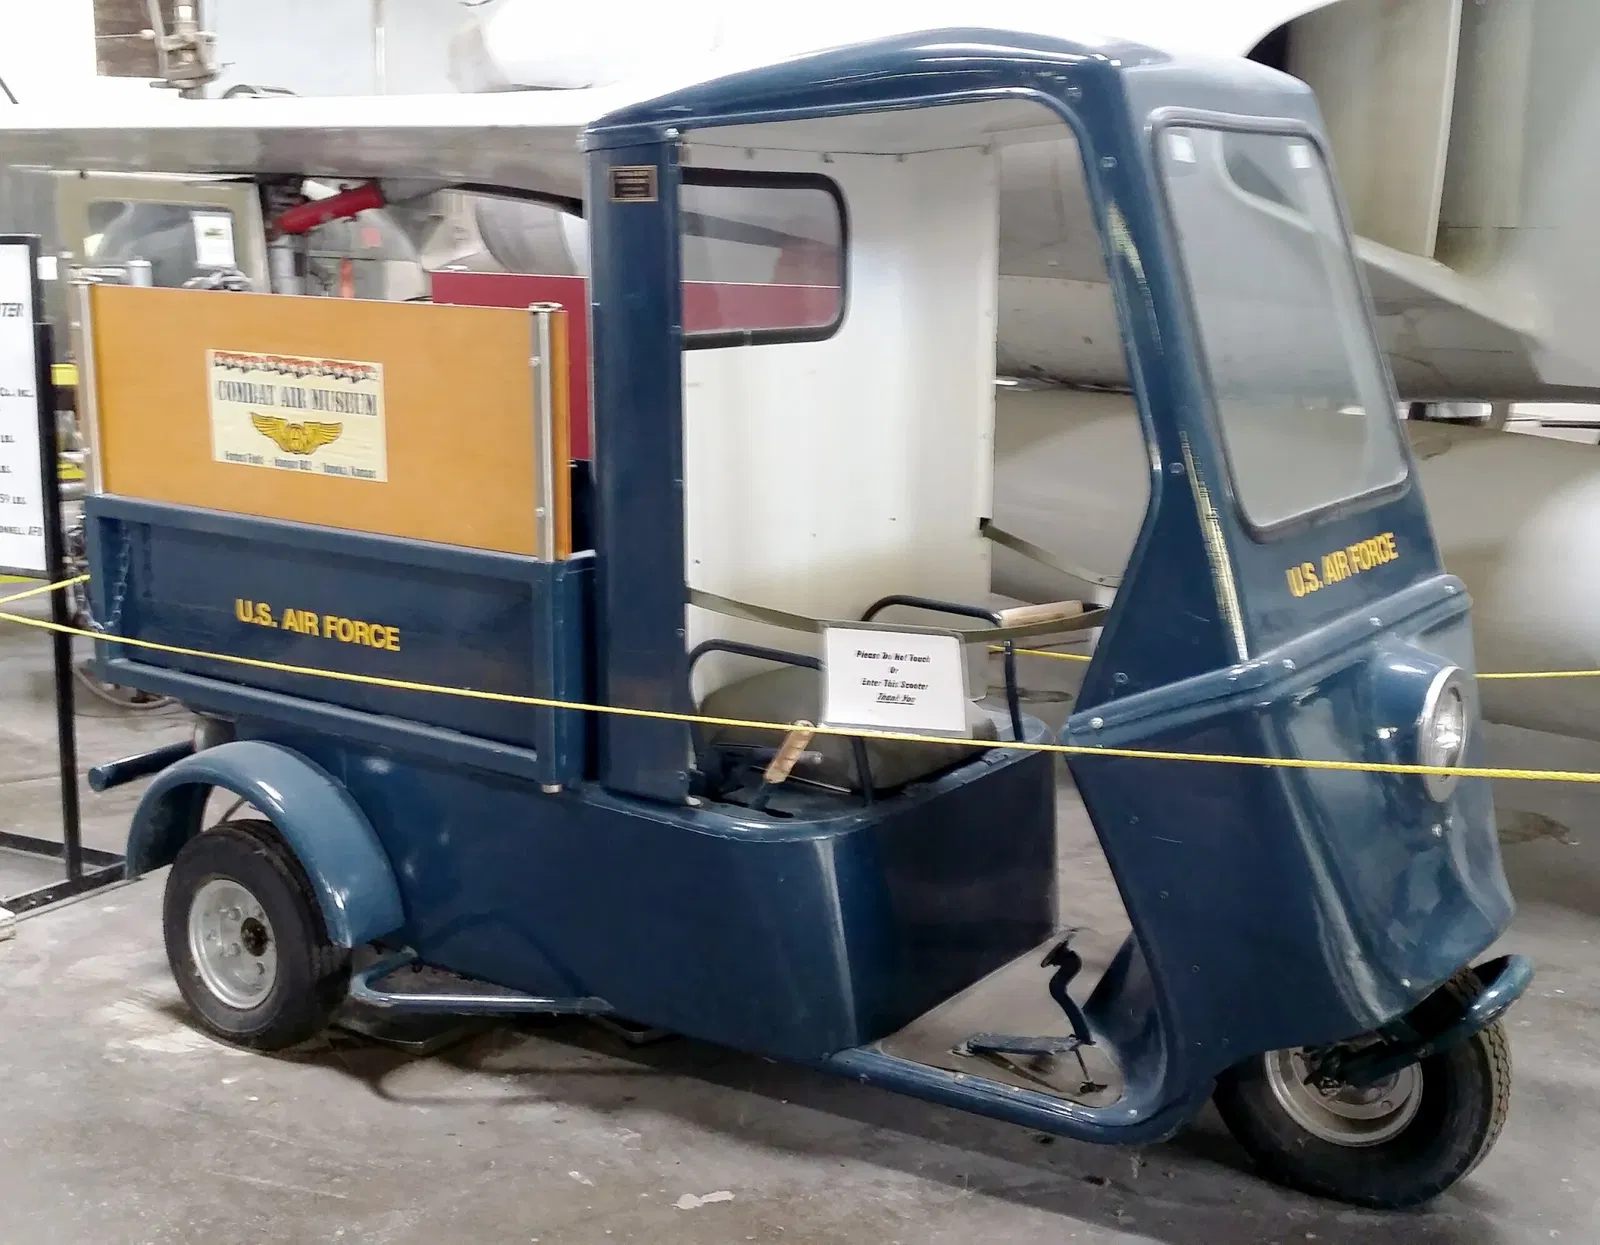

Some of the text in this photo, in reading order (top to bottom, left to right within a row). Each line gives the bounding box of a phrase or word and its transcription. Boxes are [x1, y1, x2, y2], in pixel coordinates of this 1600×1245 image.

[218, 380, 378, 416] COMBAT AIR MUSEUM
[1285, 532, 1399, 597] U.S. AIR FORCE
[235, 599, 400, 651] U.S. AIR FORCE
[856, 649, 931, 663] Please Do Not Touch
[861, 678, 929, 690] Enter This Scooter
[876, 692, 917, 703] Thank You
